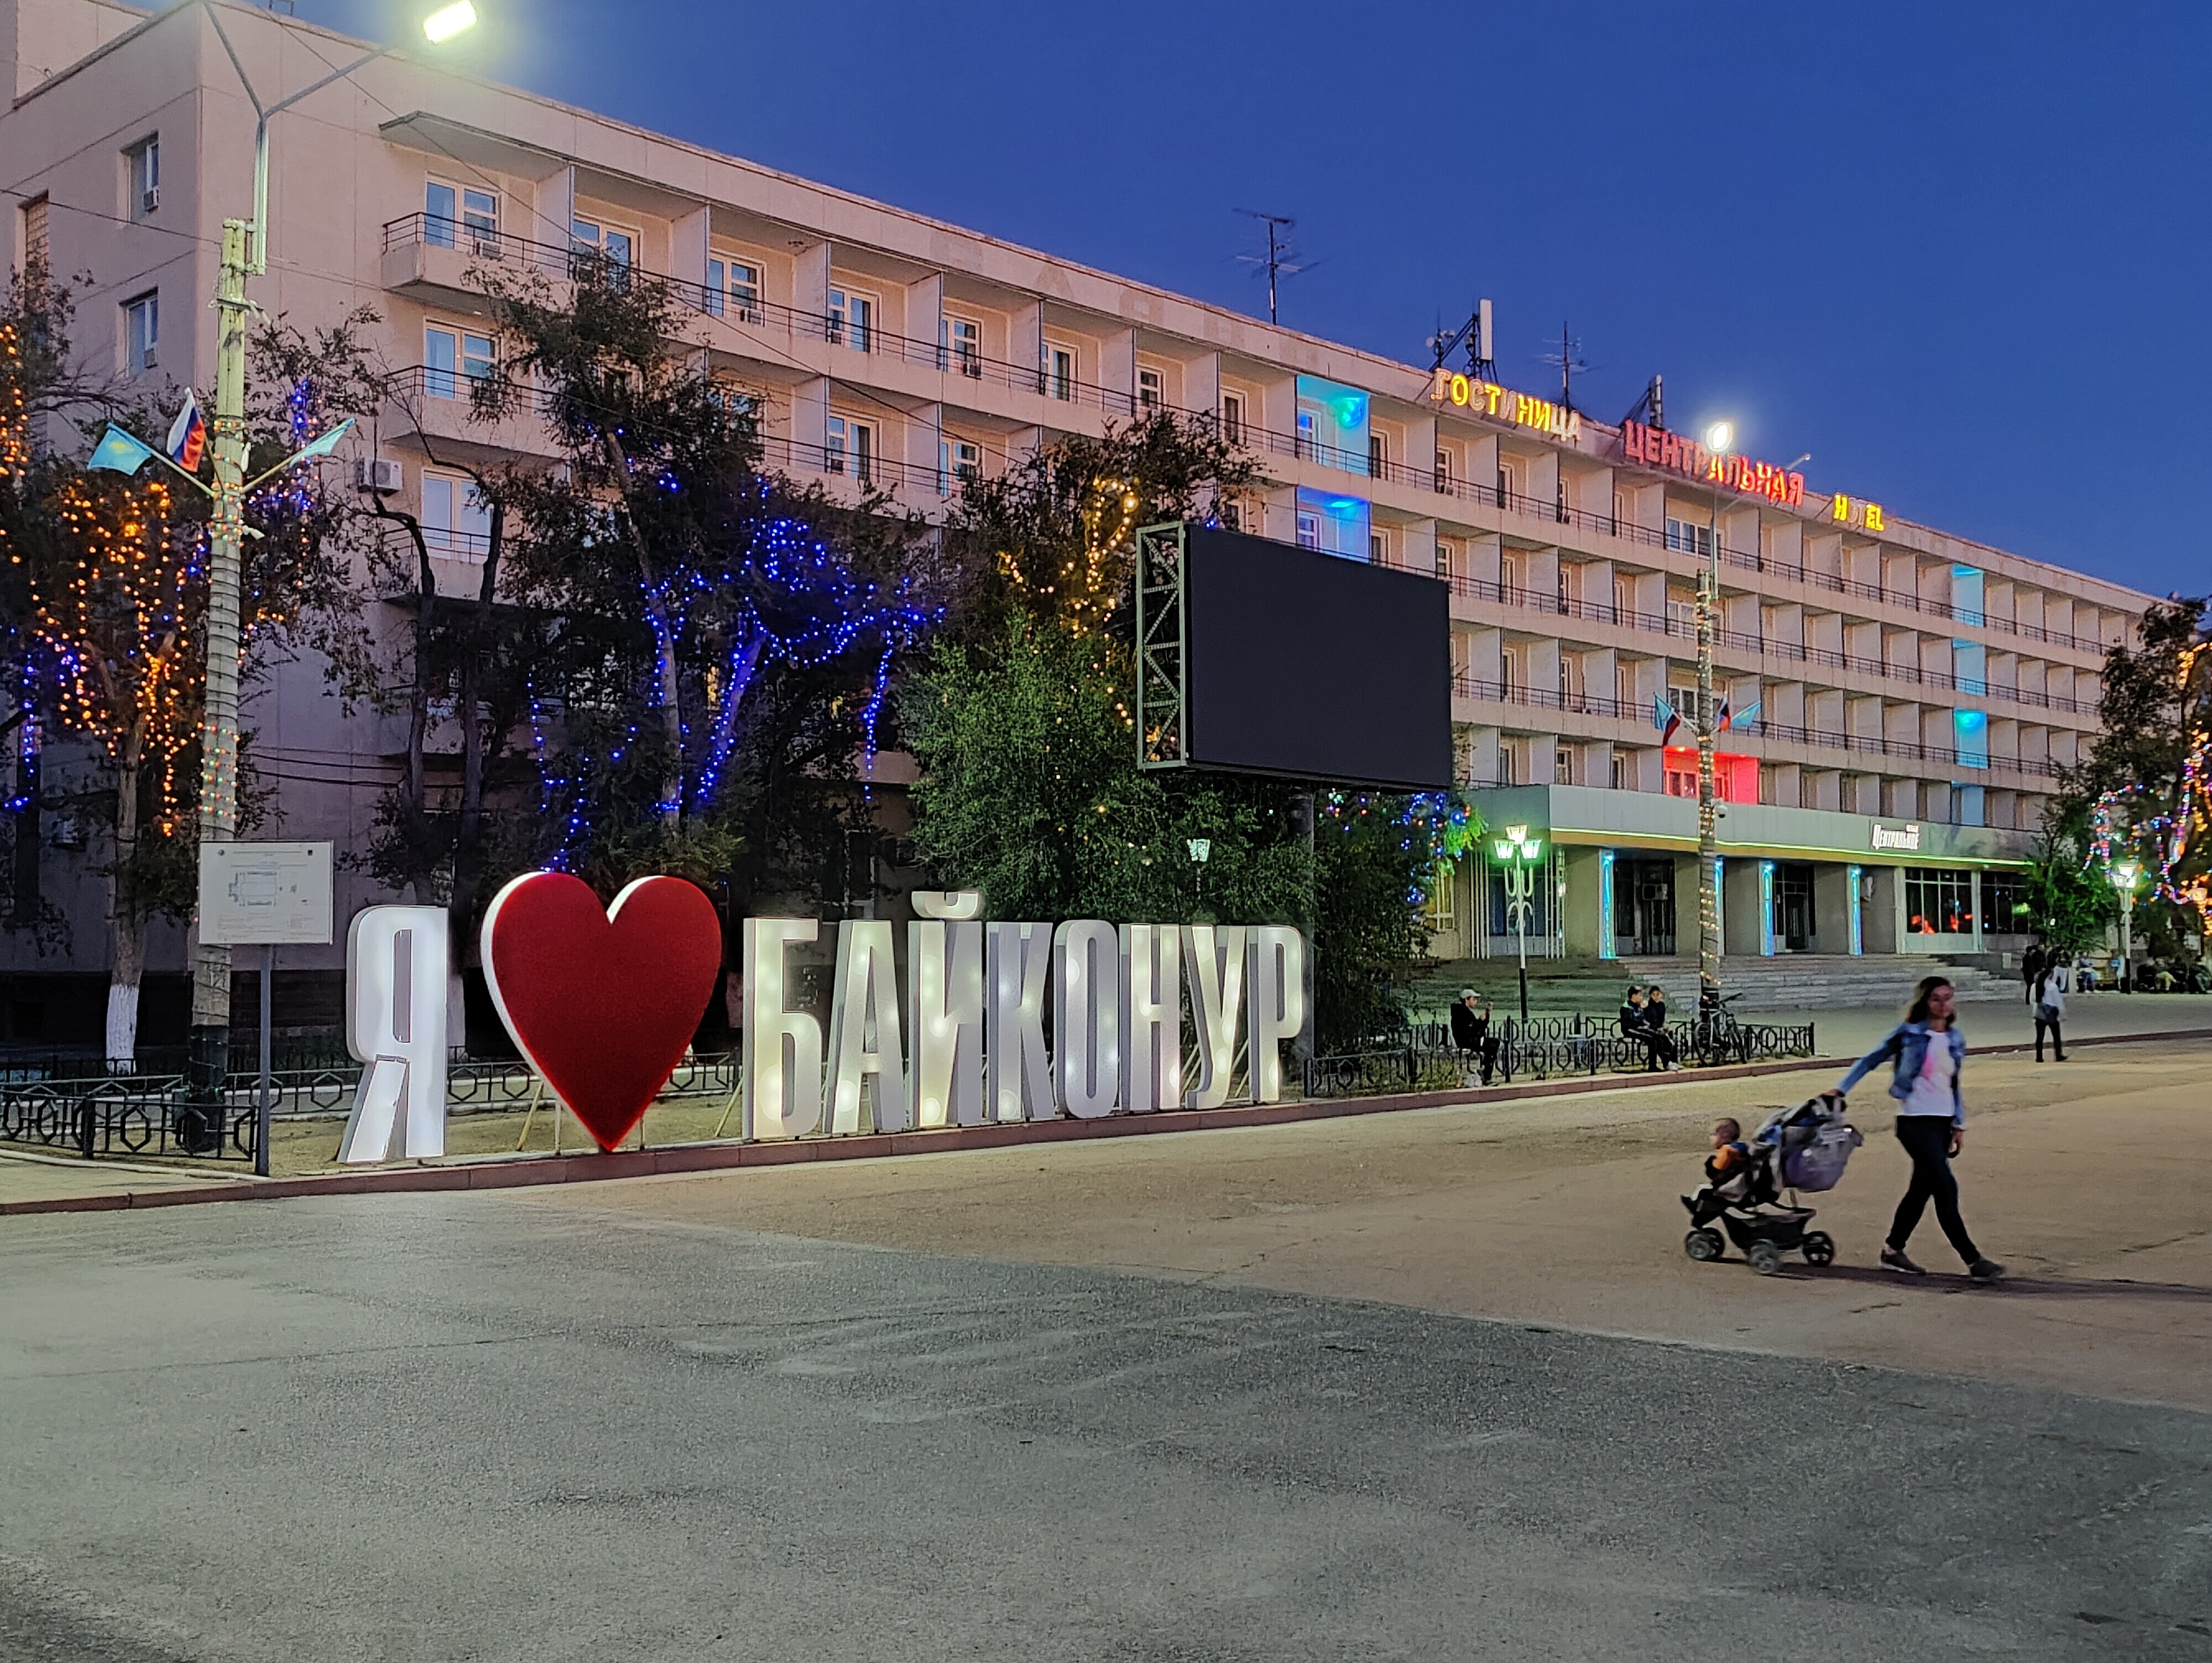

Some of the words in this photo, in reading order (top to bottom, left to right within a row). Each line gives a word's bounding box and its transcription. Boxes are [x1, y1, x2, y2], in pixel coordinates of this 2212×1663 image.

[1431, 368, 1581, 441] ГОСТИНИЦА
[1625, 419, 1804, 506] ЦЕНТРАЛЬНАЯ
[1832, 491, 1884, 530] HOTEL
[346, 906, 449, 1163] Я
[743, 892, 1304, 1141] БАЙКОНУР
